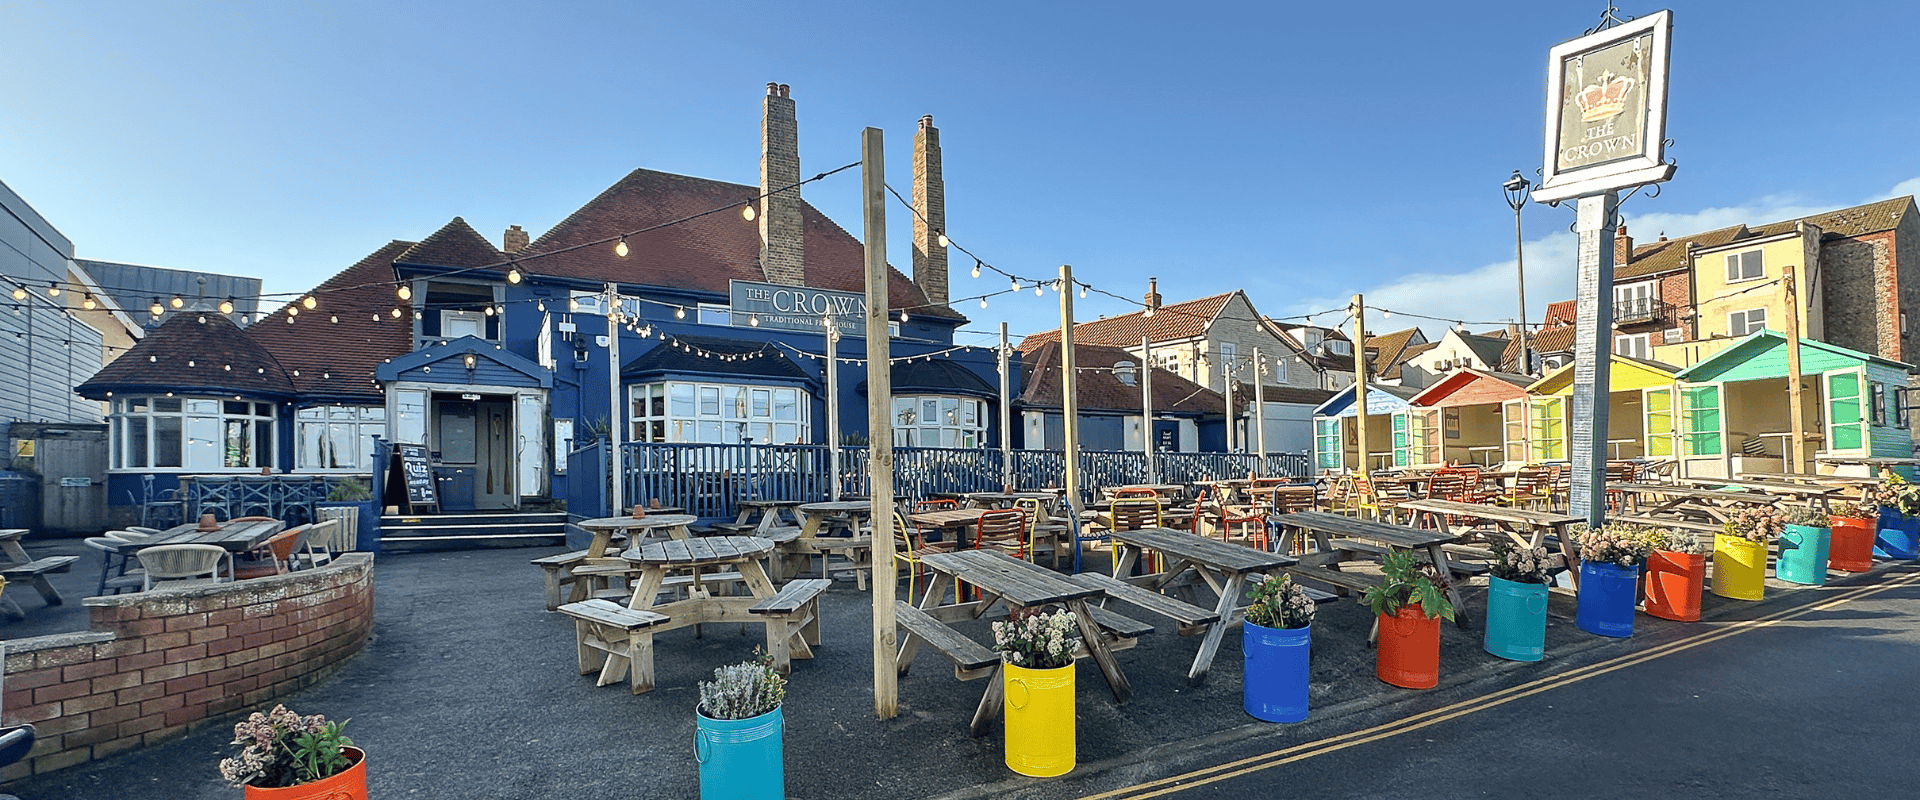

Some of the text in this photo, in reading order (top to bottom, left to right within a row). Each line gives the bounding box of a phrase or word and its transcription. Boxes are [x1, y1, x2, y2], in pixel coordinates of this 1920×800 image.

[1586, 122, 1615, 140] THE
[1564, 133, 1637, 162] CROWN
[745, 287, 771, 300] THE
[764, 315, 813, 326] TRADITIONAL
[405, 462, 428, 476] Quiz
